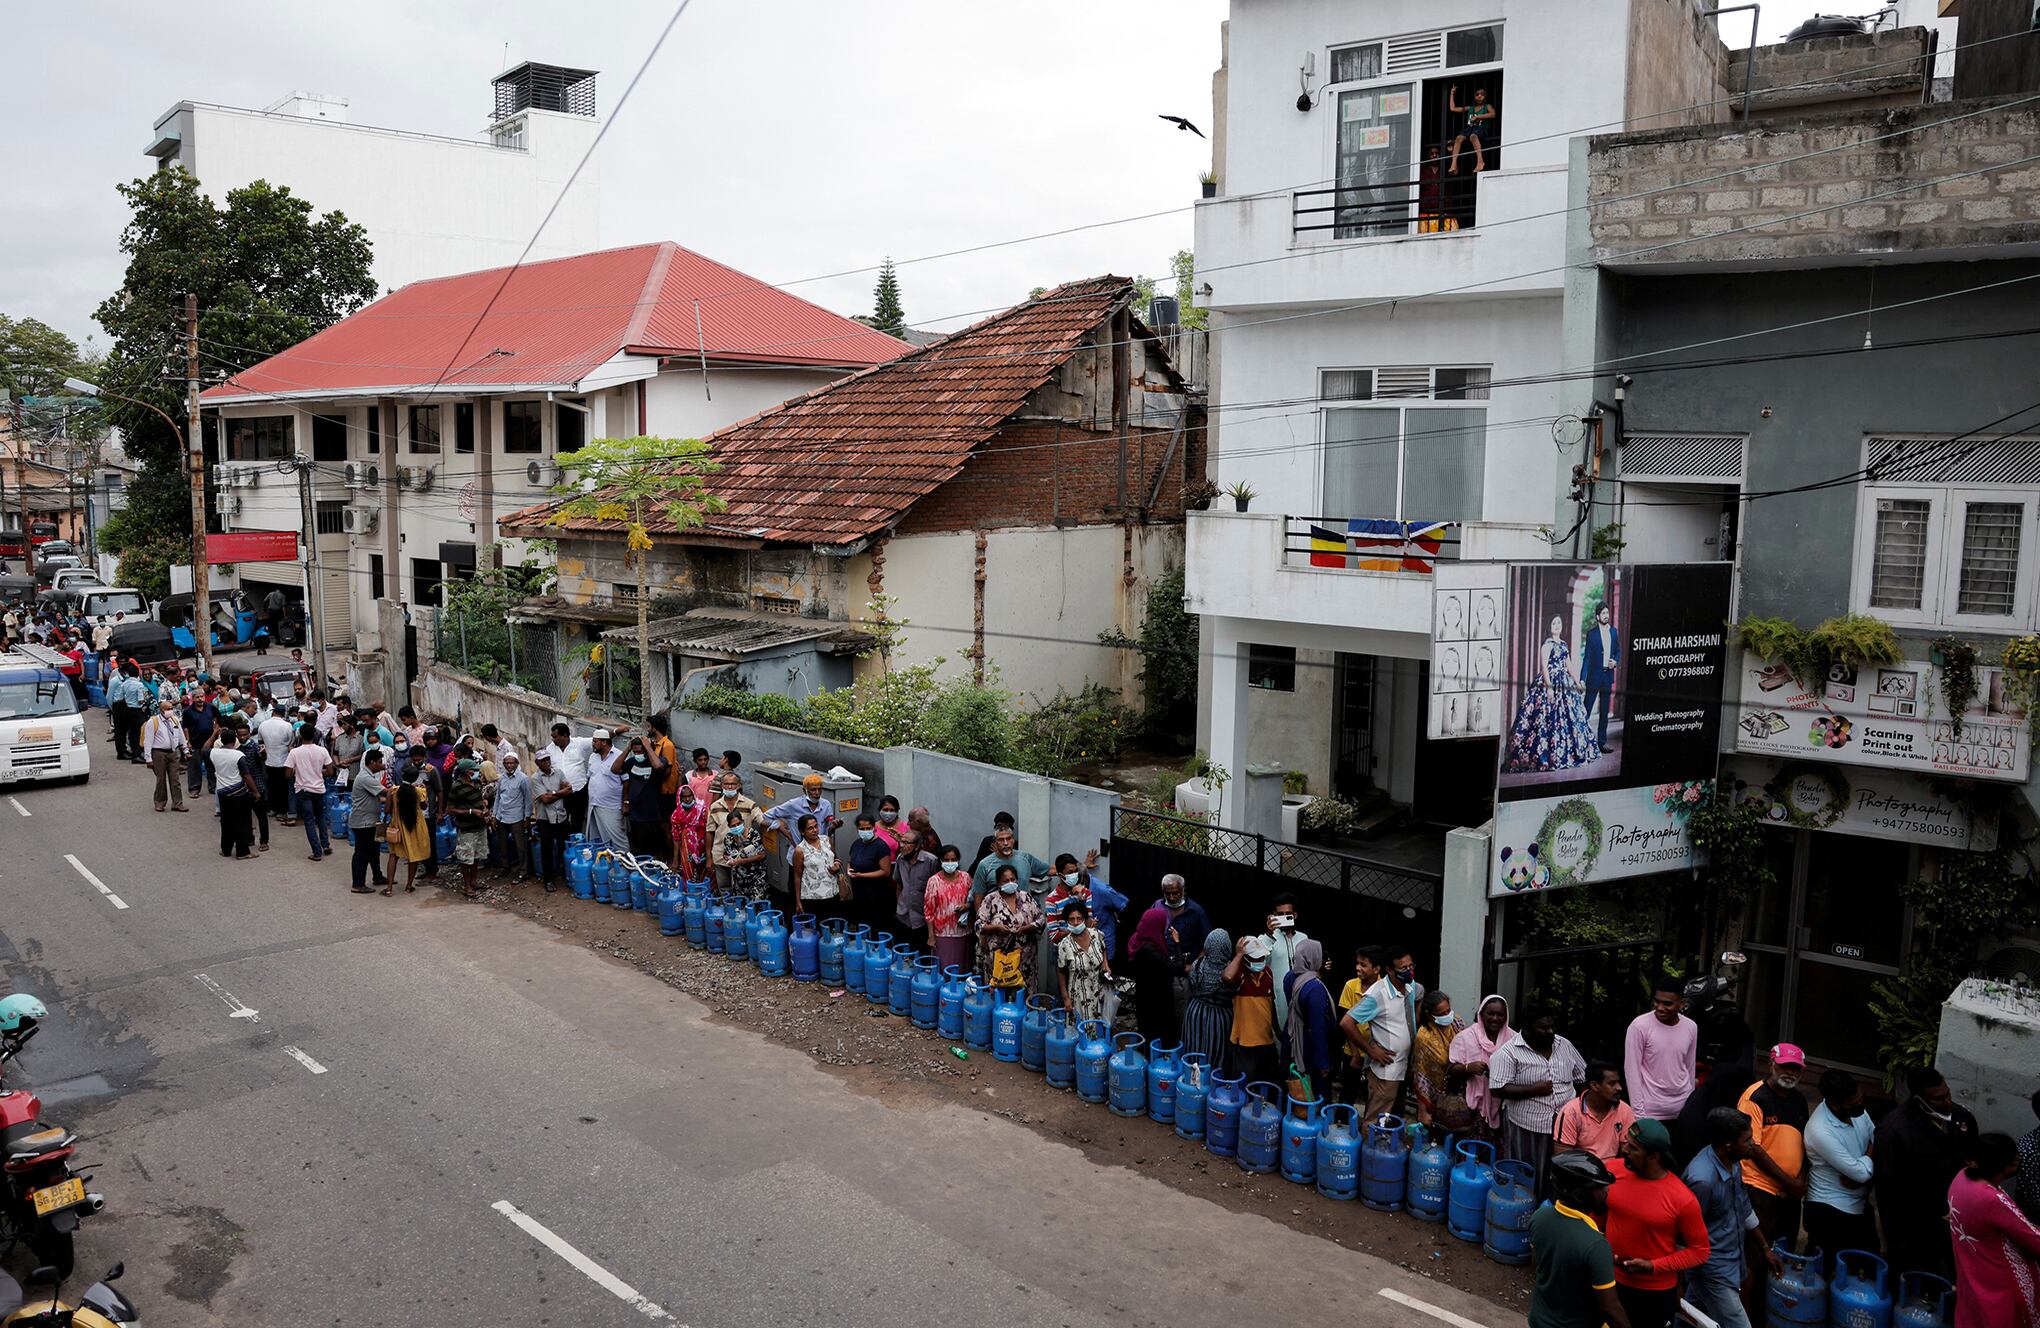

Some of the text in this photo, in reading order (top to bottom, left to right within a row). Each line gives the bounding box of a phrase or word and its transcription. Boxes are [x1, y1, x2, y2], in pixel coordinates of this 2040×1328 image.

[1633, 634, 1720, 650] SITHARA HARSHANI
[1646, 653, 1705, 666] PHOTOGRAPHY
[1668, 666, 1714, 677] 0773968087
[1786, 691, 1817, 703] PHOTO
[1790, 700, 1819, 711] PRINTS
[1634, 708, 1705, 722] Wedding Photography
[1651, 721, 1703, 733] Cinematography
[1864, 727, 1914, 743] Scaning
[1863, 739, 1913, 752] Print out
[1908, 753, 1928, 761] White
[1968, 767, 1996, 775] PHOTOS
[1856, 788, 1953, 822] Photography
[1872, 817, 1966, 839] +94775800593
[1607, 822, 1683, 852] Photography
[1620, 846, 1690, 865] +94775800593
[1835, 945, 1860, 957] OPEN
